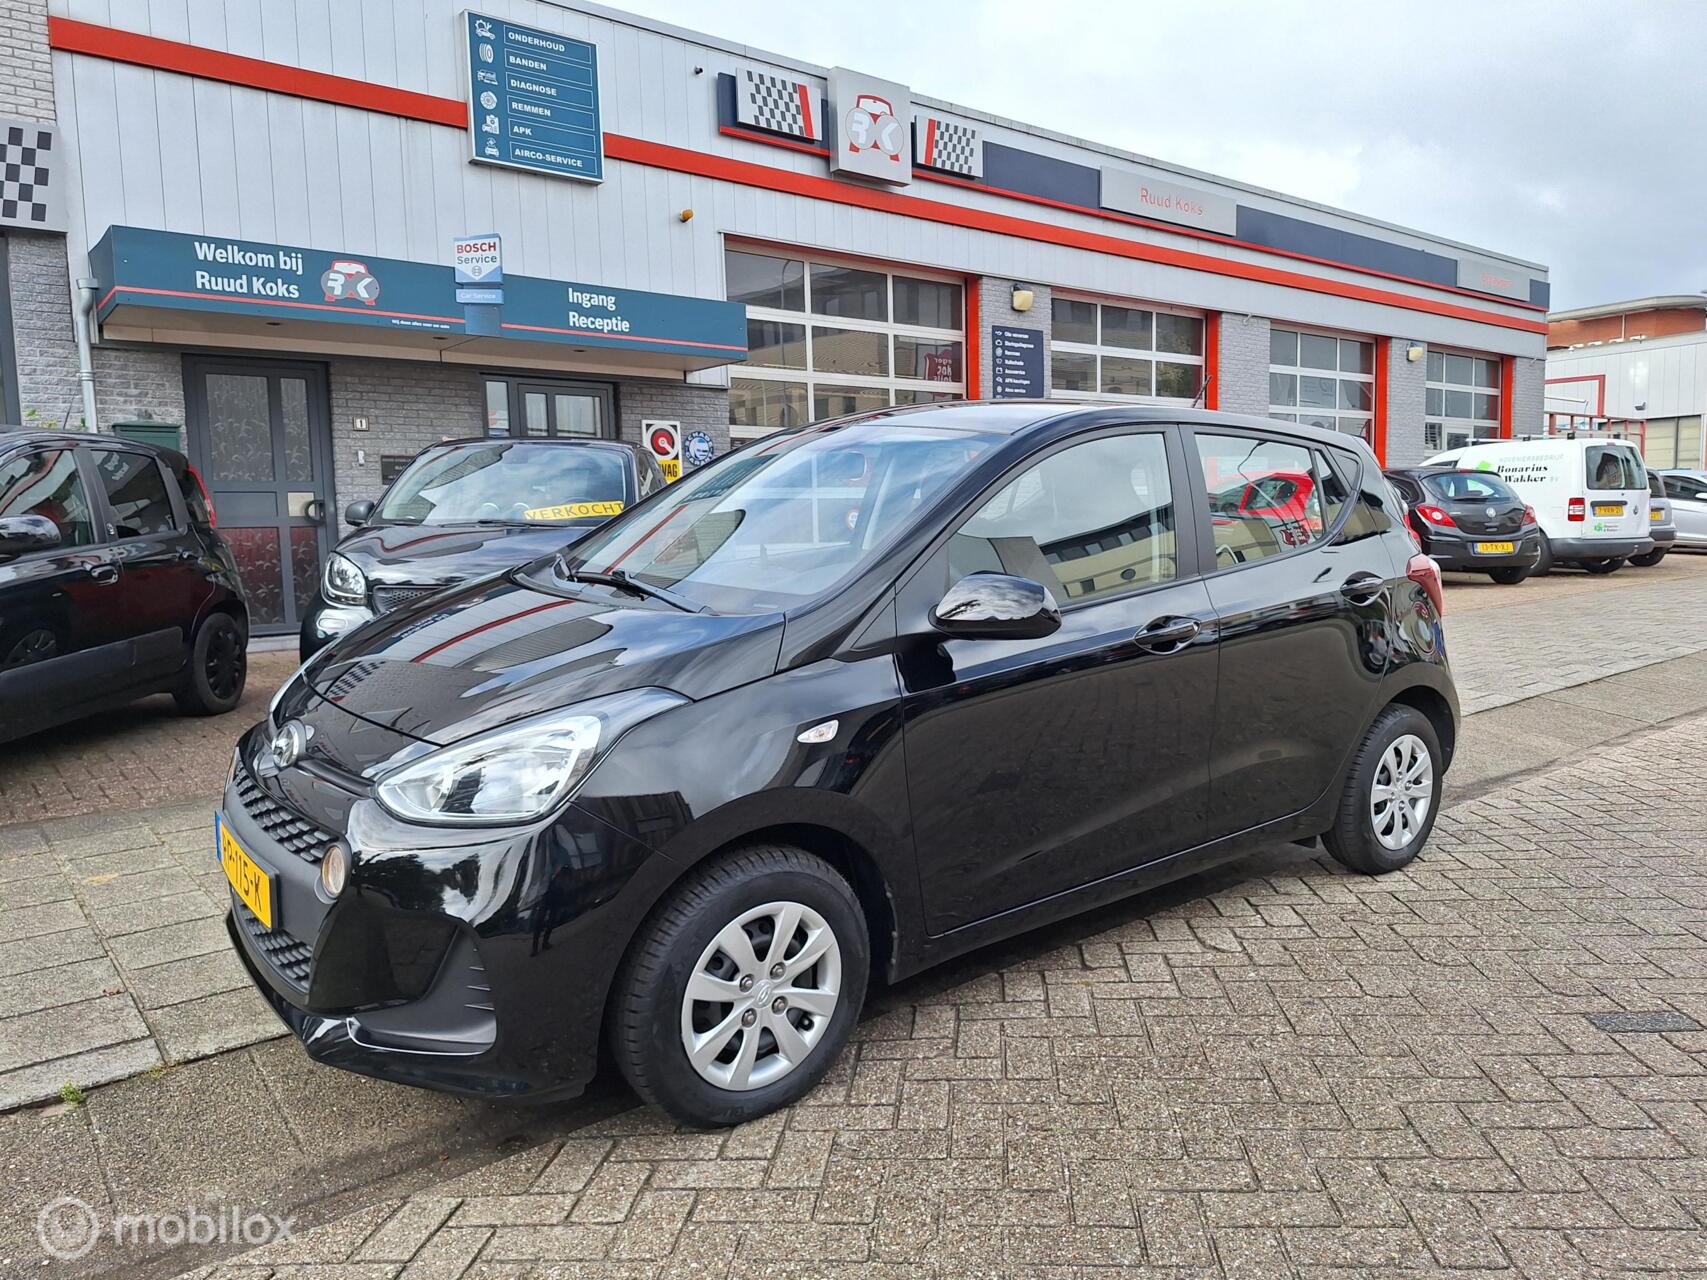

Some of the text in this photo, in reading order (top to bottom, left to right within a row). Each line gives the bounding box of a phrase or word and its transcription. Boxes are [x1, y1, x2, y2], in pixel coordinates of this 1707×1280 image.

[508, 31, 566, 52] ONDERHOUD
[509, 55, 547, 71] BANDEN
[510, 79, 557, 96] DIAGNOSE
[511, 102, 551, 117] REMMEN
[512, 125, 532, 136] APK
[514, 148, 583, 168] AIRCO-SERVICE
[1140, 187, 1204, 216] Ruud Koks
[456, 241, 497, 254] BOSCH
[194, 241, 303, 276] Welkom bij
[456, 254, 497, 265] Service
[195, 270, 300, 299] Ruud Koks
[473, 292, 497, 300] Service
[568, 287, 616, 311] Ingang
[568, 311, 630, 333] Receptie
[661, 463, 678, 478] VAG
[1497, 464, 1548, 474] Bonarius
[1504, 474, 1546, 483] Wakker
[524, 503, 624, 520] VERKOCHT
